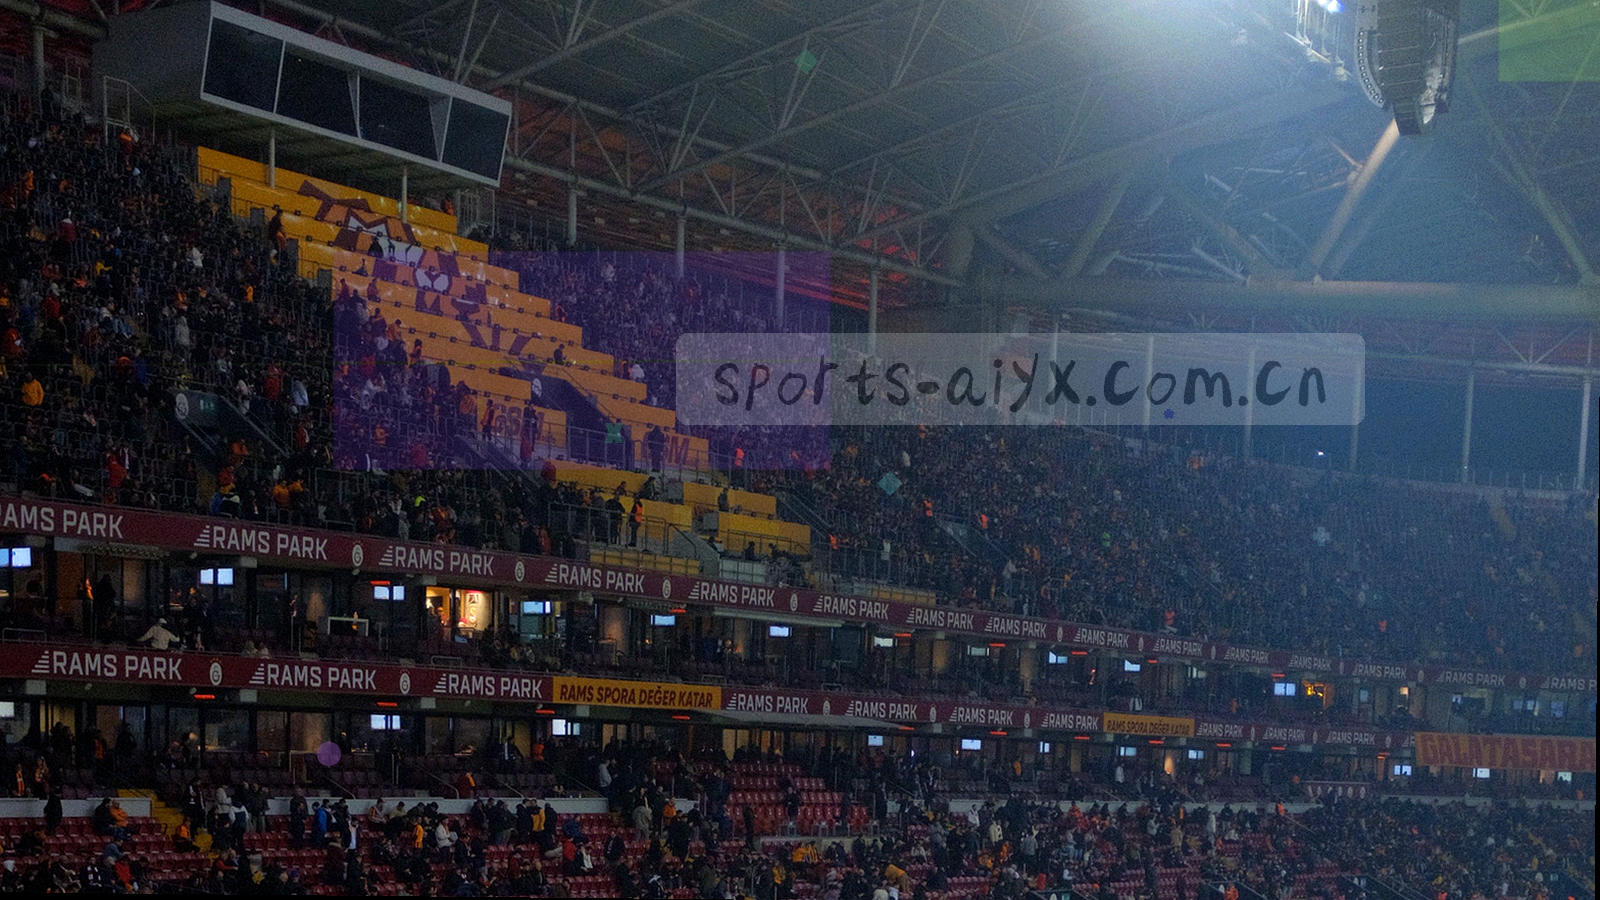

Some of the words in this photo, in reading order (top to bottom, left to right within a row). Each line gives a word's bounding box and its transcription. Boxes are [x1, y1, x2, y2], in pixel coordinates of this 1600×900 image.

[0, 503, 55, 532] AMS
[63, 509, 123, 539] PARK
[213, 526, 270, 554] RAMS
[277, 533, 328, 560] PARK
[395, 546, 445, 571] RAMS
[450, 552, 494, 576] PARK
[559, 564, 602, 588] RAMS
[606, 571, 645, 593] PARK
[700, 581, 738, 604] RAMS
[741, 587, 776, 607] PARK
[823, 595, 857, 616] RAMS
[859, 600, 889, 620] PARK
[914, 607, 945, 627] RAMS
[947, 612, 974, 630] PARK
[992, 617, 1020, 635] RAMS
[1022, 621, 1047, 639] PARK
[1080, 628, 1106, 645] RAMS
[1107, 632, 1130, 649] PARK
[1160, 639, 1182, 654] RAMS
[1184, 642, 1203, 656] PARK
[53, 651, 118, 678] RAMS
[125, 656, 182, 681] PARK
[1230, 648, 1250, 662] RAMS
[1251, 650, 1270, 665] PARK
[267, 664, 322, 688] RAMS
[328, 667, 376, 690] PARK
[1358, 664, 1383, 678] RAMS
[1385, 667, 1407, 681] PARK
[1446, 671, 1474, 685] RAMS
[1477, 674, 1506, 687] PARK
[449, 674, 496, 697] RAMS
[500, 677, 543, 699] PARK
[1551, 676, 1586, 691] RAMS
[560, 684, 594, 702] RAMS
[596, 687, 636, 705] SPORA
[640, 685, 678, 707] DEĞER
[679, 690, 713, 709] KATAR
[737, 693, 773, 712] RAMS
[777, 696, 809, 714] PARK
[854, 700, 886, 718] RAMS
[889, 703, 917, 720] PARK
[957, 707, 985, 724] RAMS
[988, 709, 1013, 726] PARK
[1049, 714, 1074, 729] RAMS
[1076, 716, 1099, 732] PARK
[1203, 723, 1224, 737] RAMS
[1225, 725, 1244, 739] PARK
[1332, 731, 1353, 744] RAMS
[1354, 733, 1376, 746] PARK
